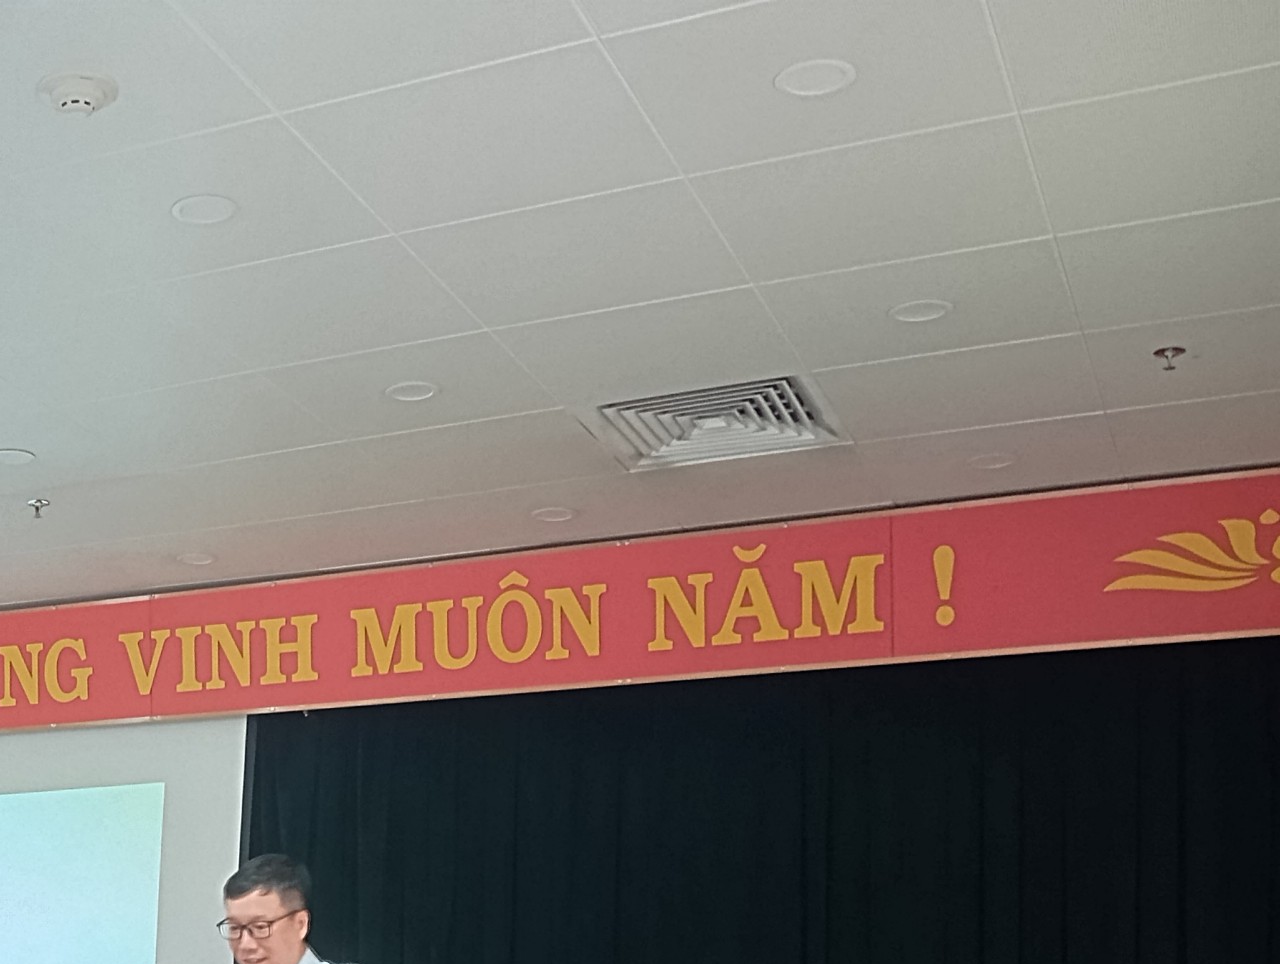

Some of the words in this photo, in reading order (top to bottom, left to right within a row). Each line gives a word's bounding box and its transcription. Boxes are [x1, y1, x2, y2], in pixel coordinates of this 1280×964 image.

[118, 613, 320, 697] VINH
[350, 570, 608, 678] MUÔN
[647, 543, 885, 652] NĂM
